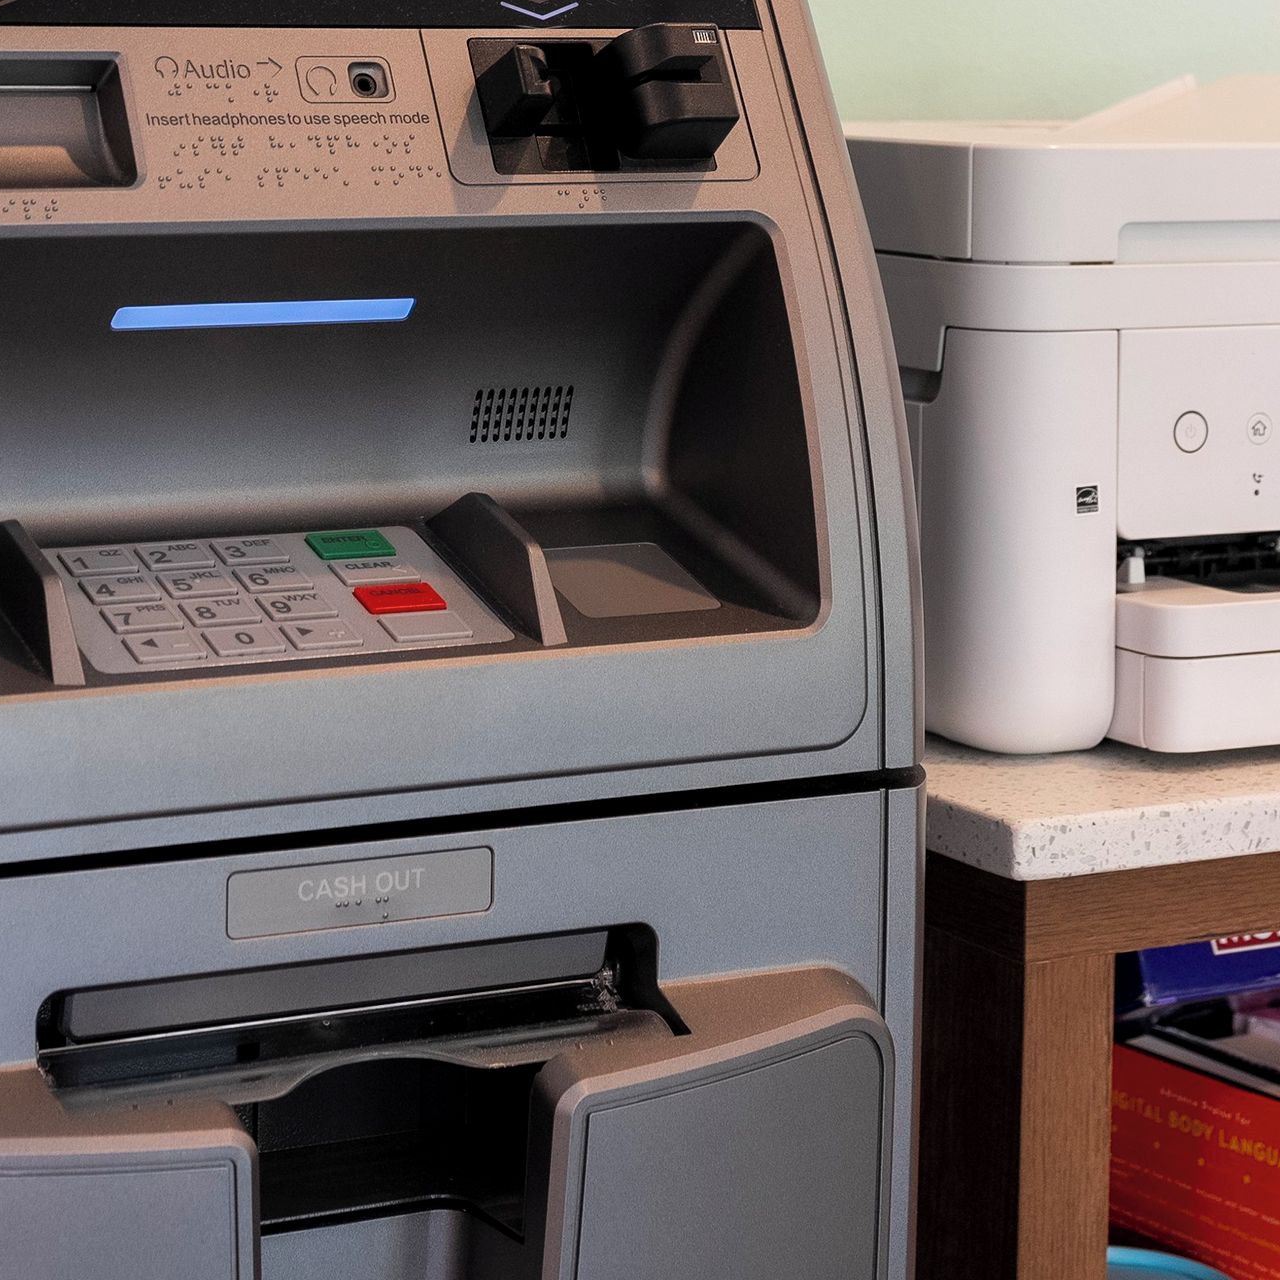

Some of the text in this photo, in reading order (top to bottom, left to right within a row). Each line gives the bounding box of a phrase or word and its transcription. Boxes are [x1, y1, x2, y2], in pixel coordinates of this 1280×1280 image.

[184, 58, 251, 79] Audio
[146, 112, 430, 128] Insert headphones to use speech mode
[167, 543, 197, 552] ABC
[241, 539, 270, 547] DEF
[98, 549, 121, 557] QZ
[149, 551, 172, 563] 2
[225, 546, 246, 558] 3
[73, 557, 89, 569] 1
[344, 561, 393, 570] CLEAR
[189, 571, 220, 580] JKL
[262, 566, 296, 574] MNO
[116, 576, 144, 584] GHI
[172, 579, 193, 591] 5
[248, 573, 269, 586] 6
[96, 584, 115, 596] 4
[211, 599, 240, 607] TUV
[282, 593, 318, 601] WXY
[195, 606, 216, 619] 8
[270, 601, 291, 613] 9
[113, 612, 131, 625] 7
[235, 632, 254, 644] 0
[297, 868, 426, 902] CASH OUT
[1169, 1110, 1214, 1141] BODY
